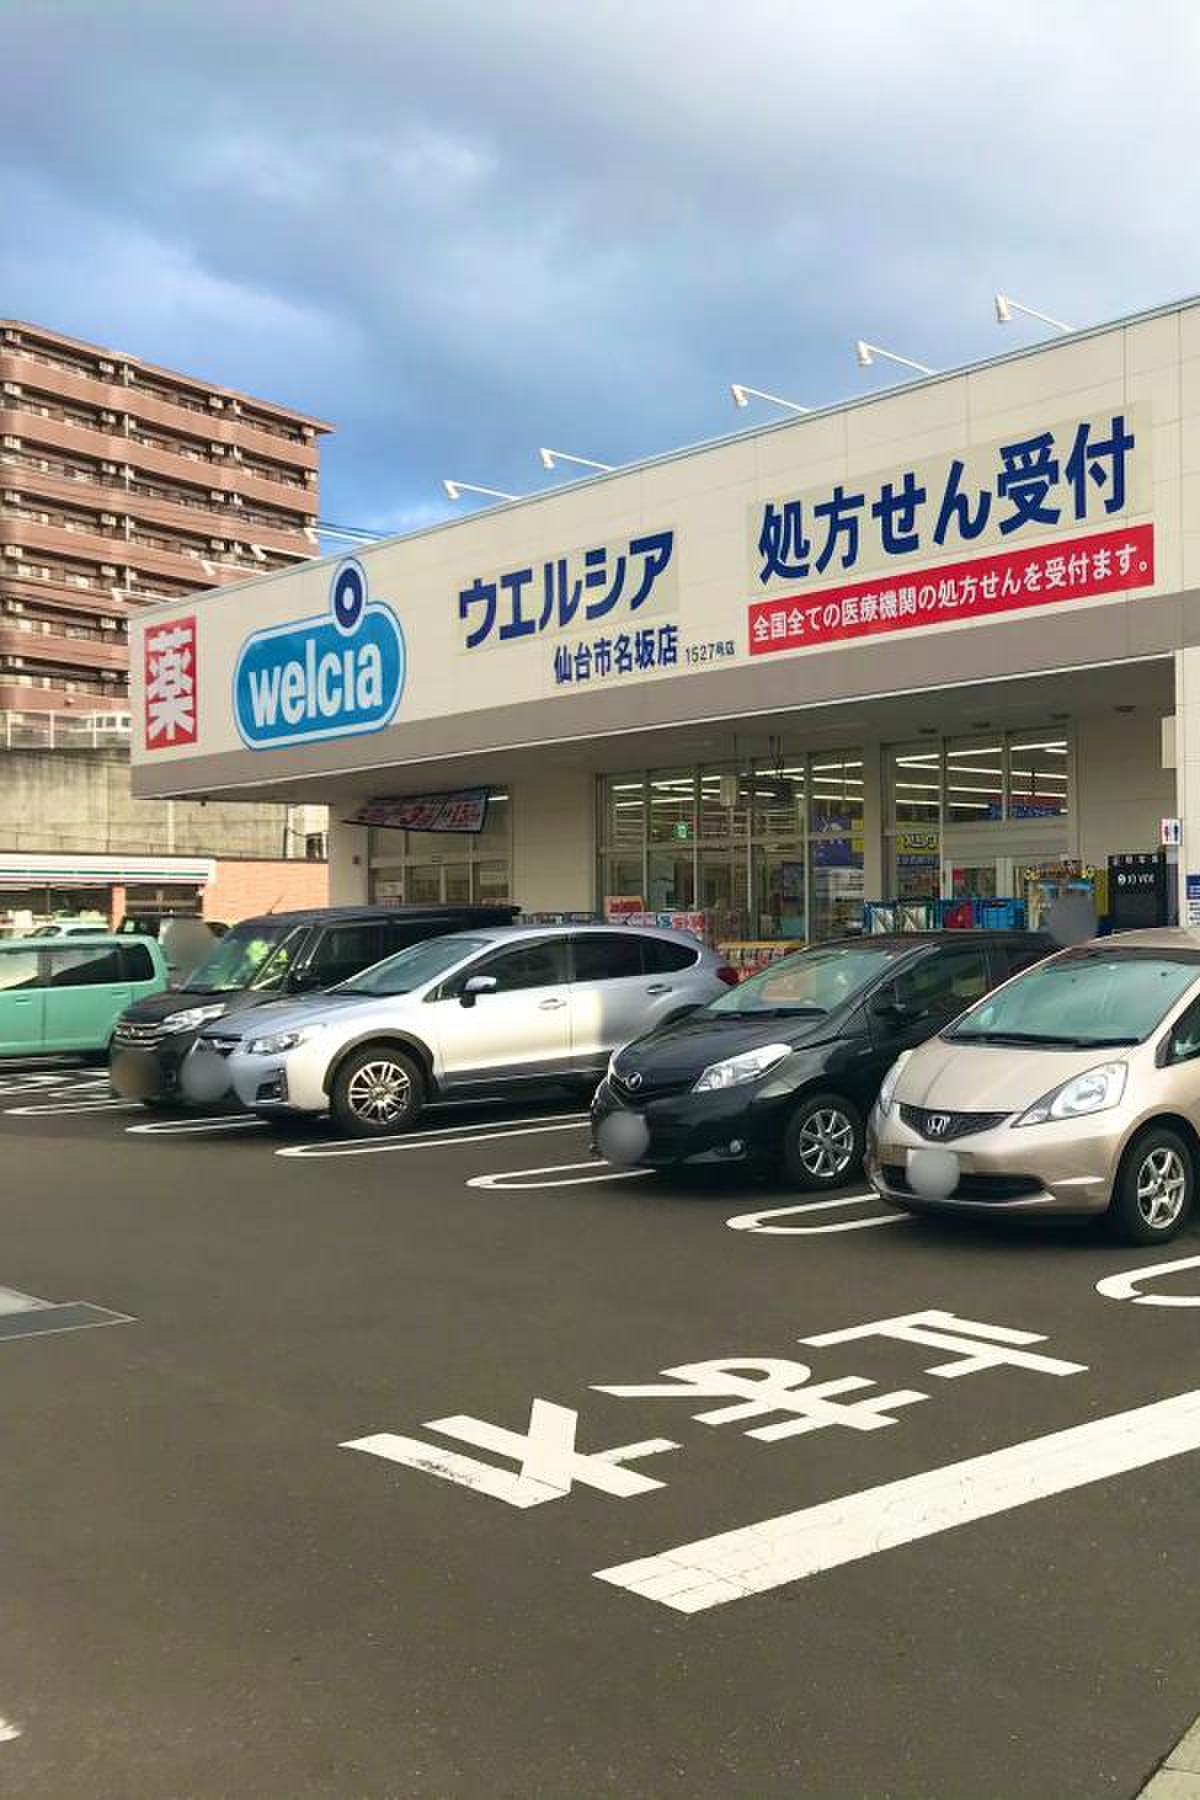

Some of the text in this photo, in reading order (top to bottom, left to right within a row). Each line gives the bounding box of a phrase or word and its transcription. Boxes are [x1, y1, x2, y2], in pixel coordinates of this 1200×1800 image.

[757, 415, 1136, 585] 処方せん受付
[458, 530, 674, 648] ウエルシア
[753, 543, 1149, 643] 全国全ての医療機関の処方せんを受付ます。
[148, 627, 194, 740] 薬
[249, 639, 384, 728] welcia
[553, 623, 678, 685] 仙台市名坂店
